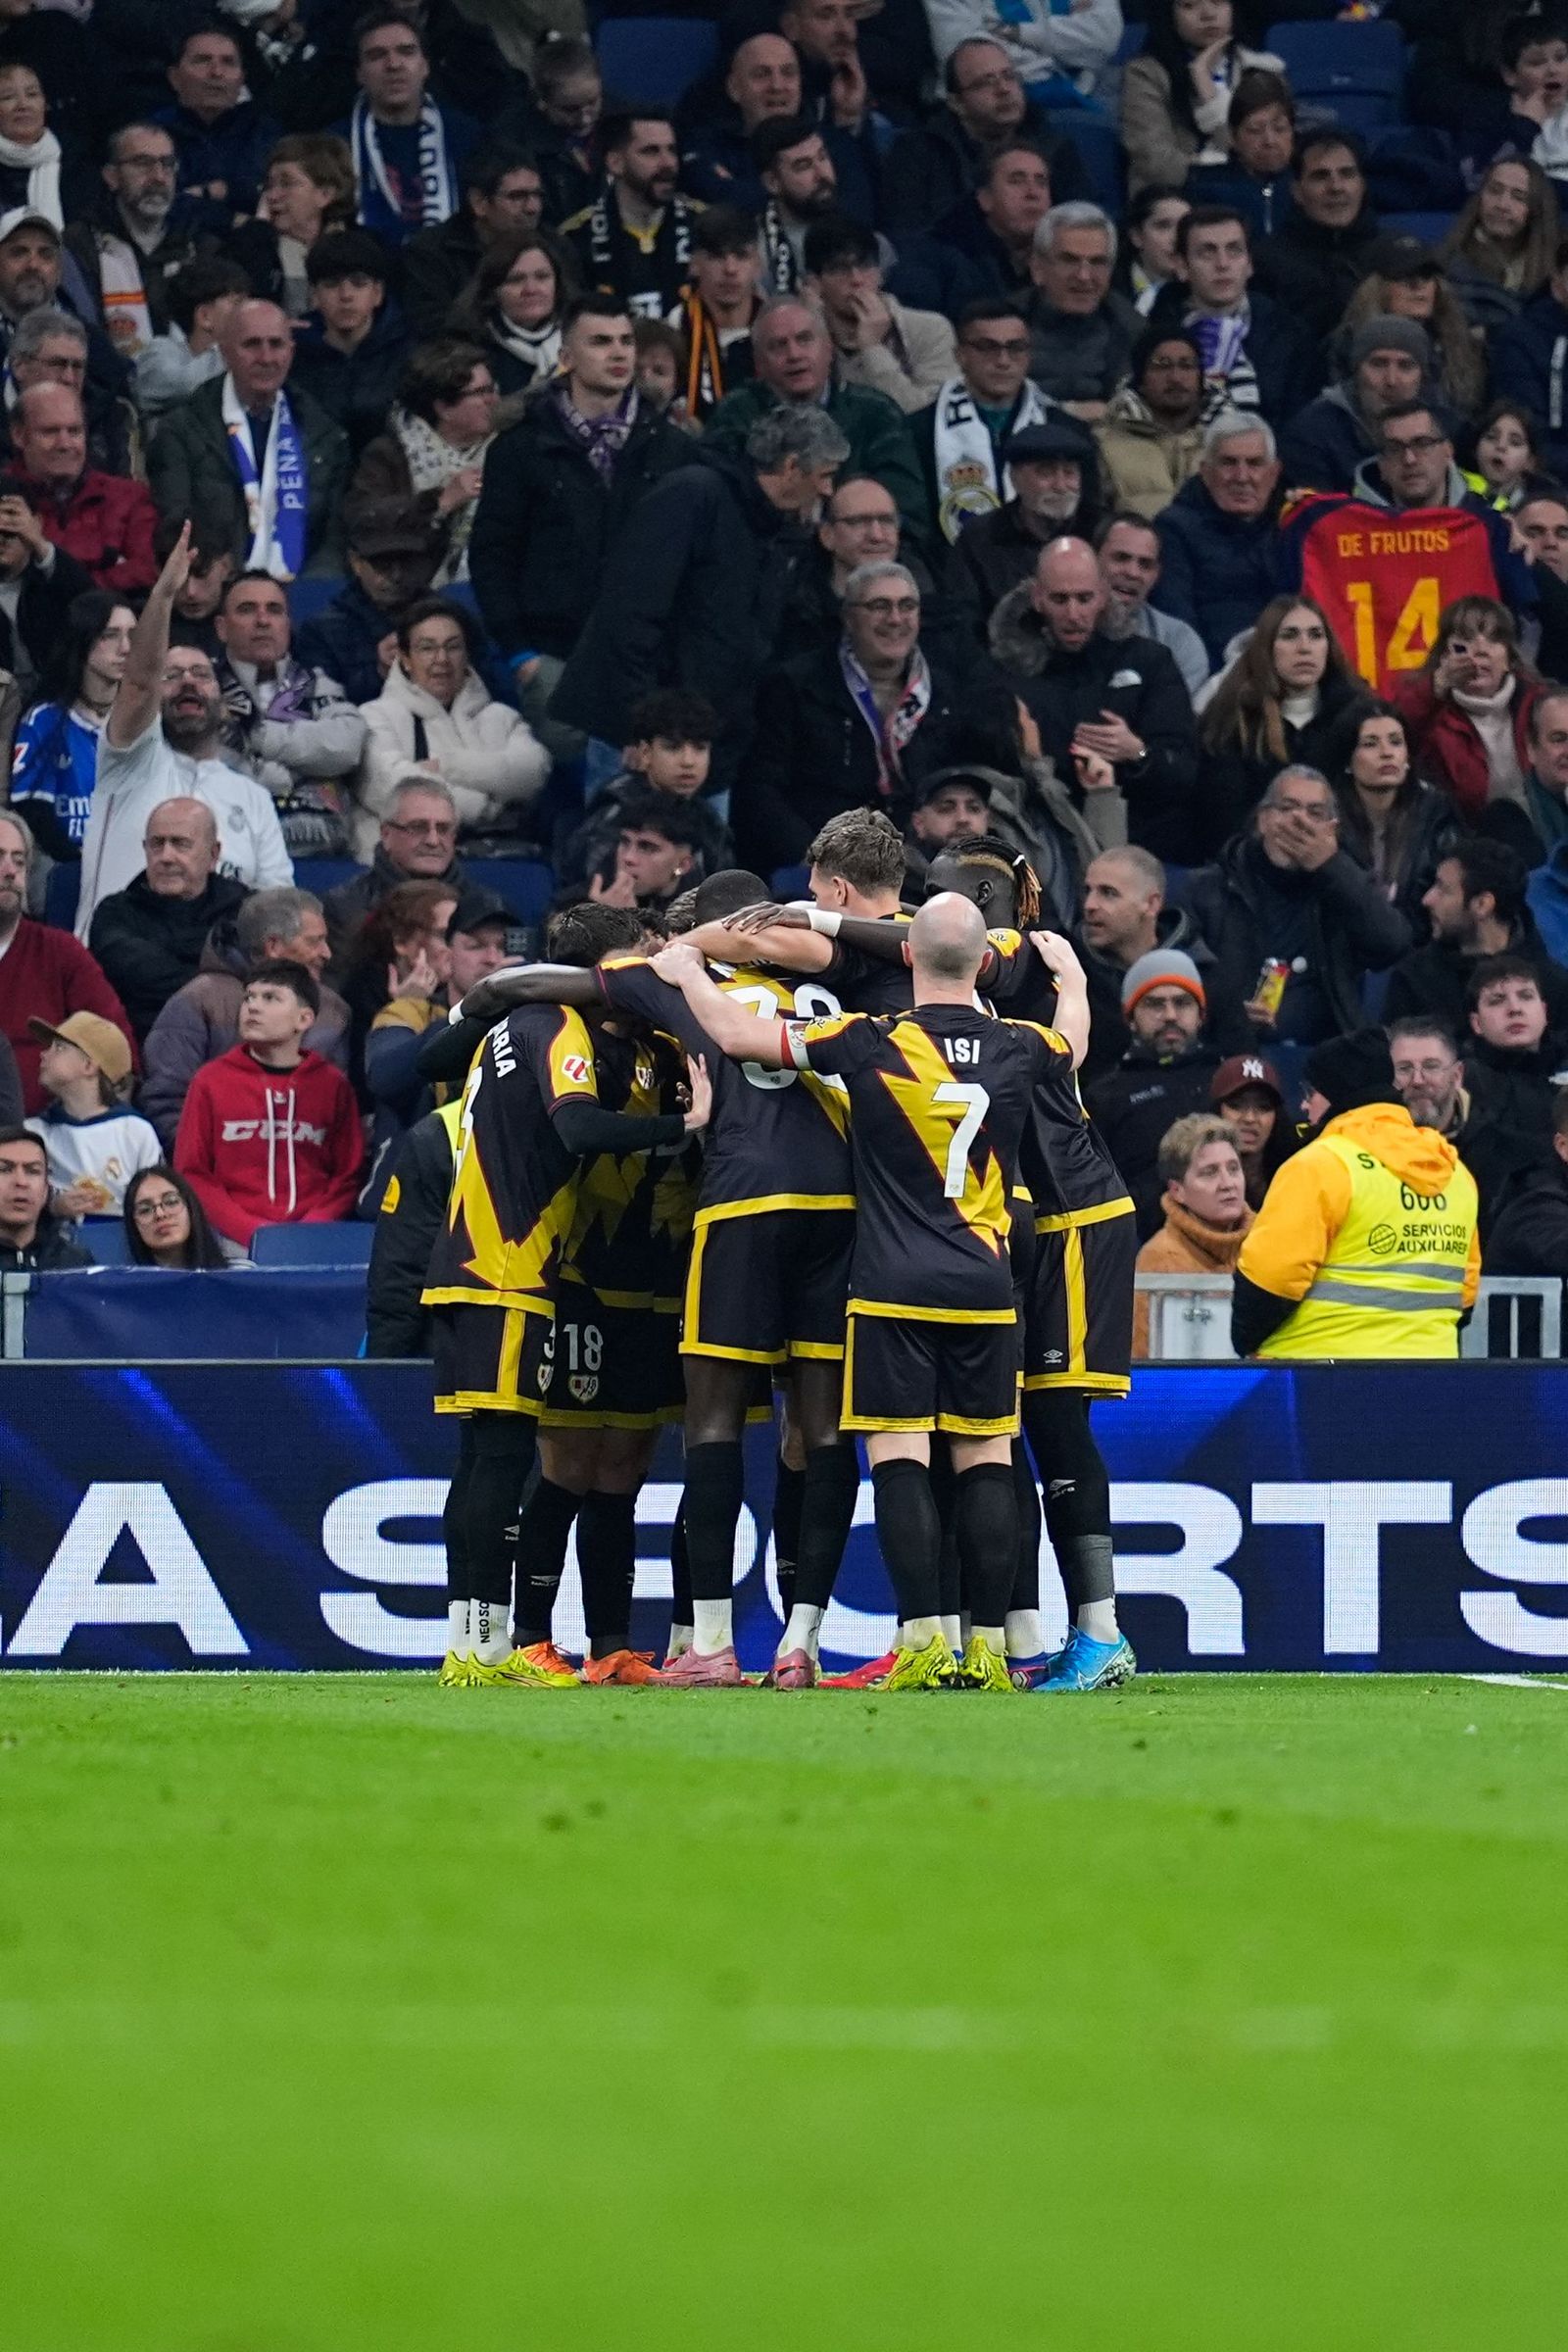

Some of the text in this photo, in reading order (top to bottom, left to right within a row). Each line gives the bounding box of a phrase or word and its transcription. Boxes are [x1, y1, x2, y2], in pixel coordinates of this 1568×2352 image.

[1338, 530, 1449, 557] DE FRUTOS
[1347, 576, 1441, 690] 14
[944, 1038, 980, 1064] ISI
[932, 1082, 991, 1198] 7
[1396, 1240, 1468, 1254] AUXILIARES
[1402, 1224, 1466, 1239] SERVICIOS
[563, 1324, 604, 1371] 18
[0, 1482, 251, 1654] A
